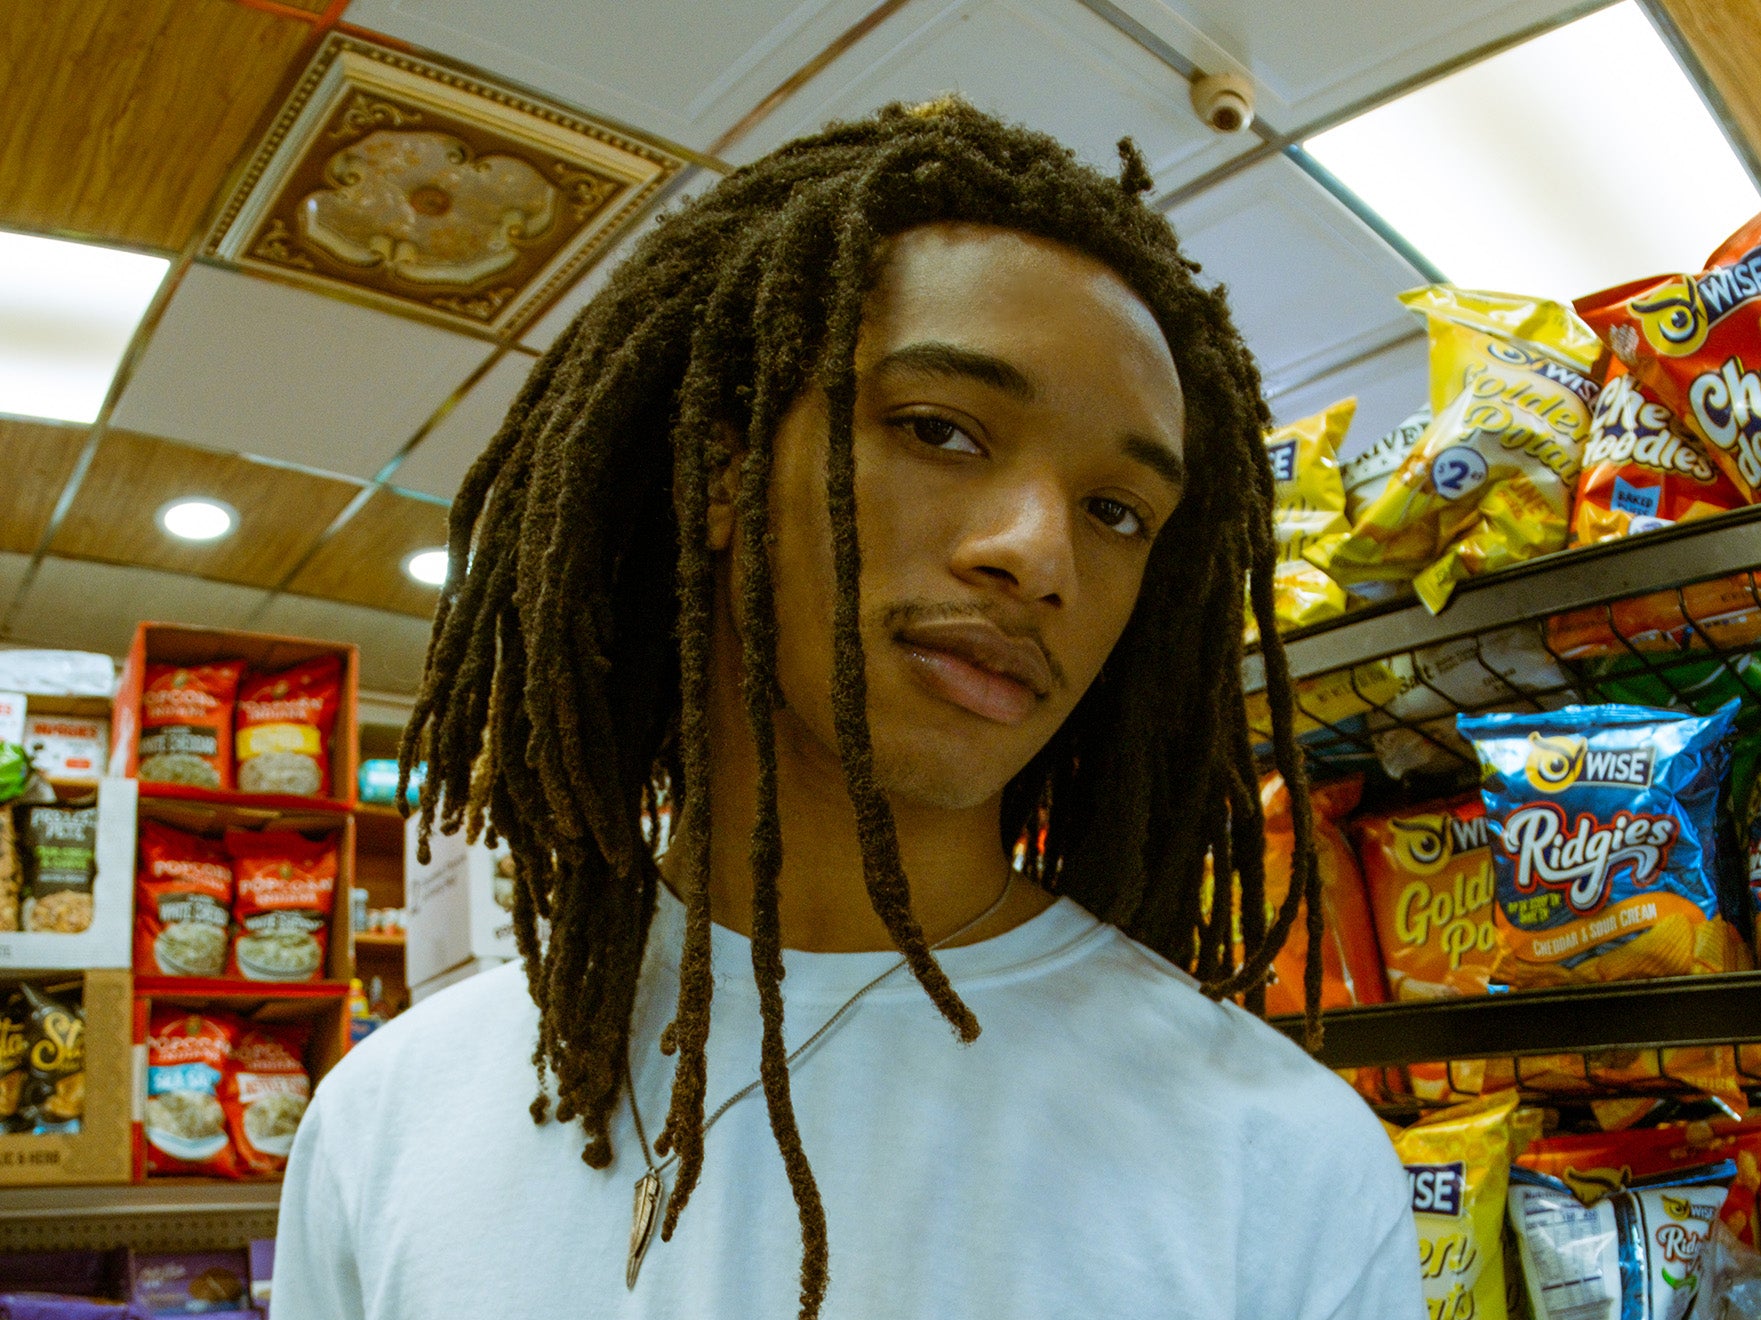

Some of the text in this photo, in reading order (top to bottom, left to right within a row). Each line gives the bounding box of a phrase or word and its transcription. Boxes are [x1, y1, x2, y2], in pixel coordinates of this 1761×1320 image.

[1545, 362, 1601, 404] WIS
[1586, 749, 1648, 784] WISE
[1451, 817, 1490, 850] WI
[1504, 807, 1674, 910] Ridgies
[1396, 860, 1494, 945] Gold
[1532, 929, 1579, 957] CHEDDAR
[1589, 915, 1619, 939] SOUR
[1619, 902, 1658, 927] CREAM
[1408, 1171, 1456, 1212] ISE
